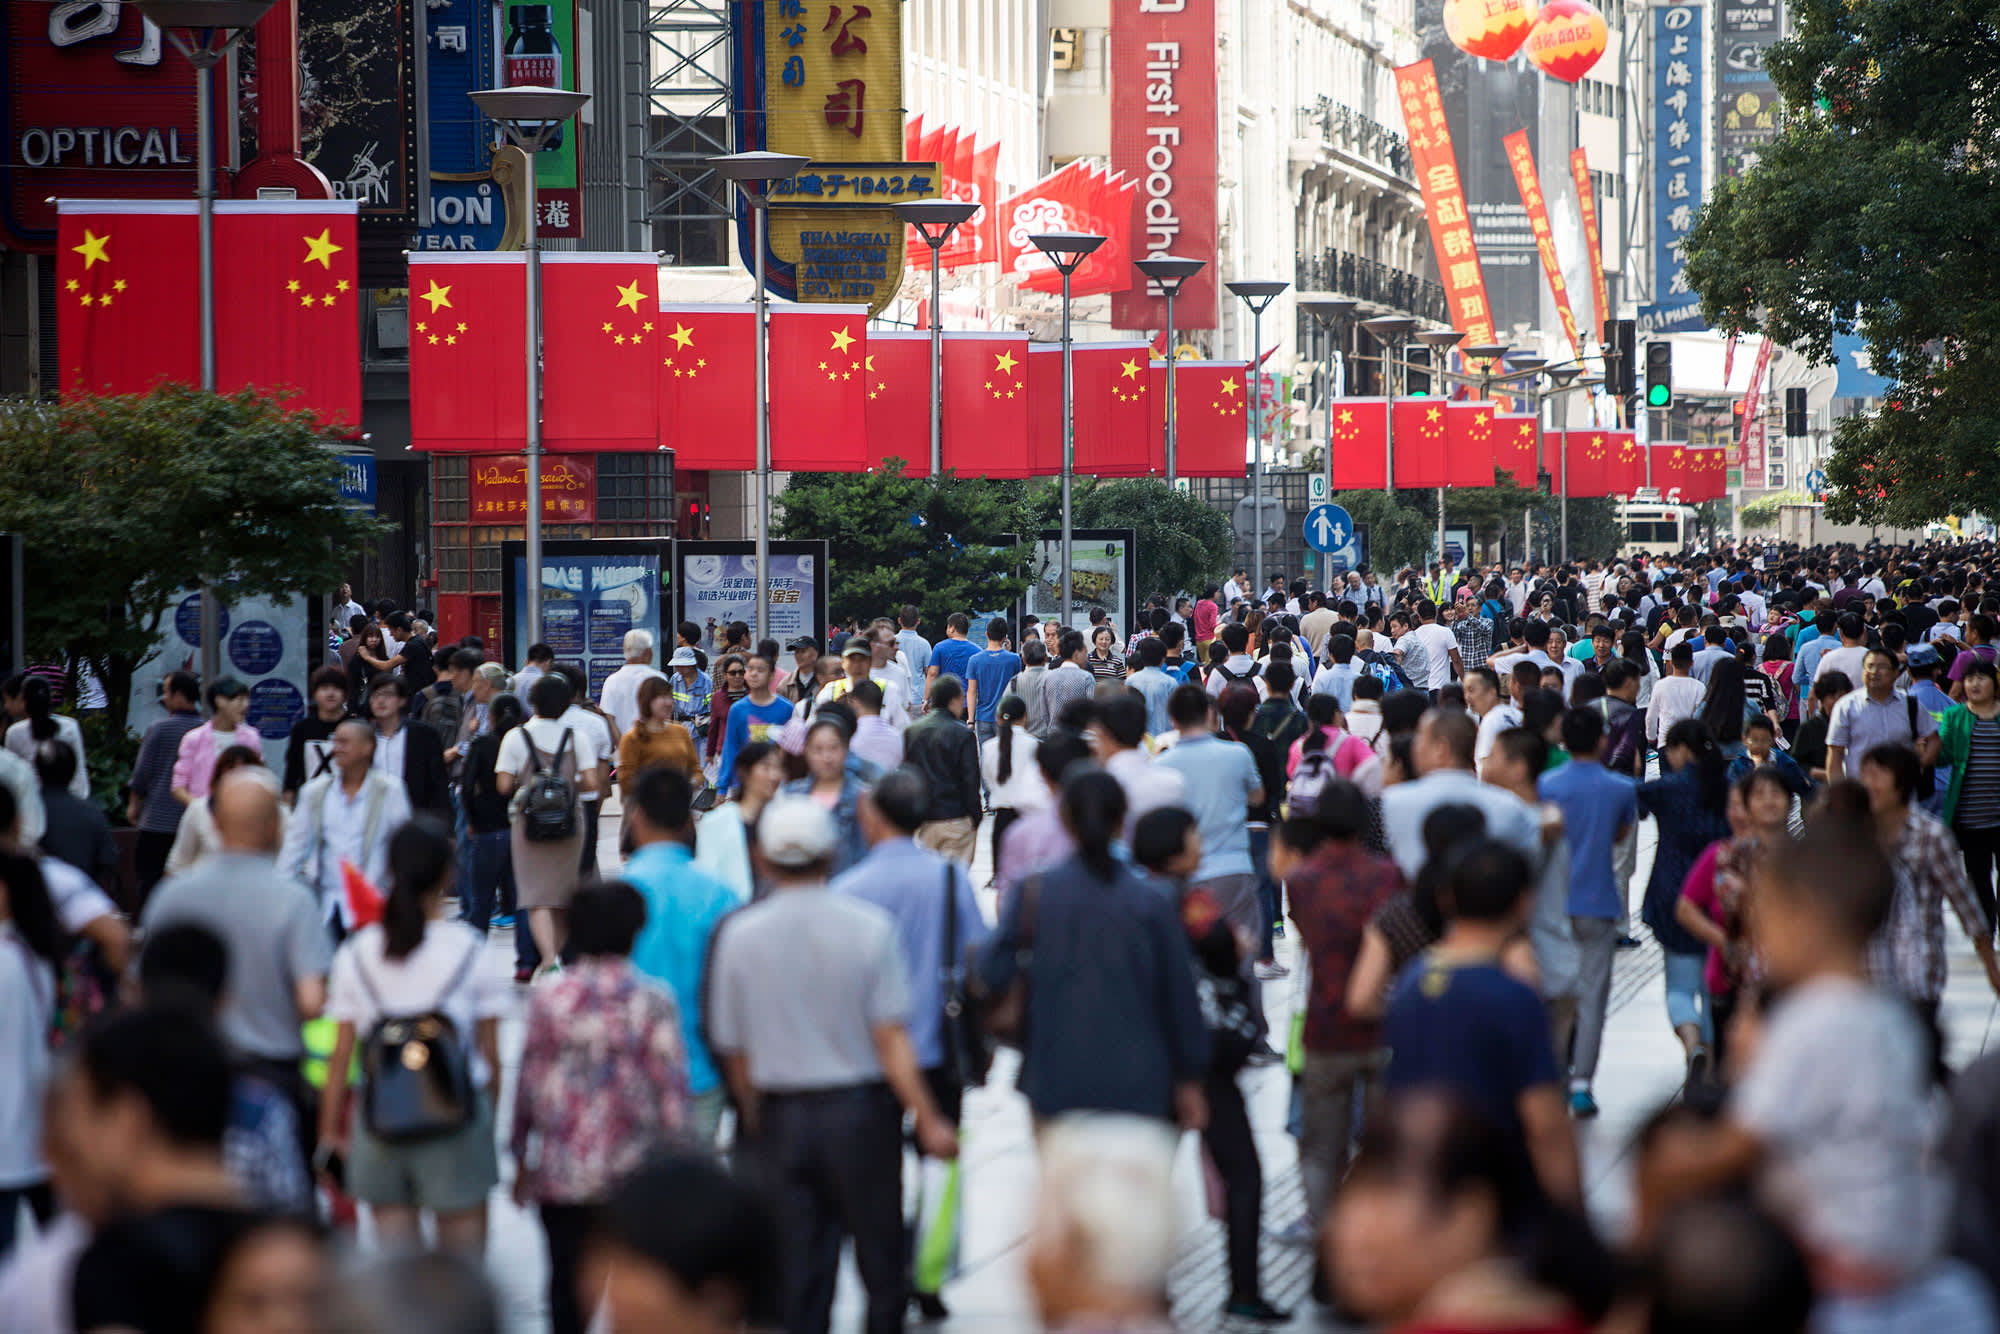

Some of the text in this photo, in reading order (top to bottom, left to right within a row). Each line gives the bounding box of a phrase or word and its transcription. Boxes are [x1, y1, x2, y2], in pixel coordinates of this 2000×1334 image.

[823, 5, 872, 138] 公司
[1146, 42, 1180, 117] First
[21, 126, 193, 166] OPTICAL
[800, 231, 891, 247] SHANGHAI
[803, 247, 887, 263] BEDROOM
[804, 264, 887, 280] ARTICLES
[477, 464, 577, 491] Madame Tsauds
[477, 500, 585, 513] 上海杜莎夫蜡像馆
[722, 577, 793, 589] 现金管帮手
